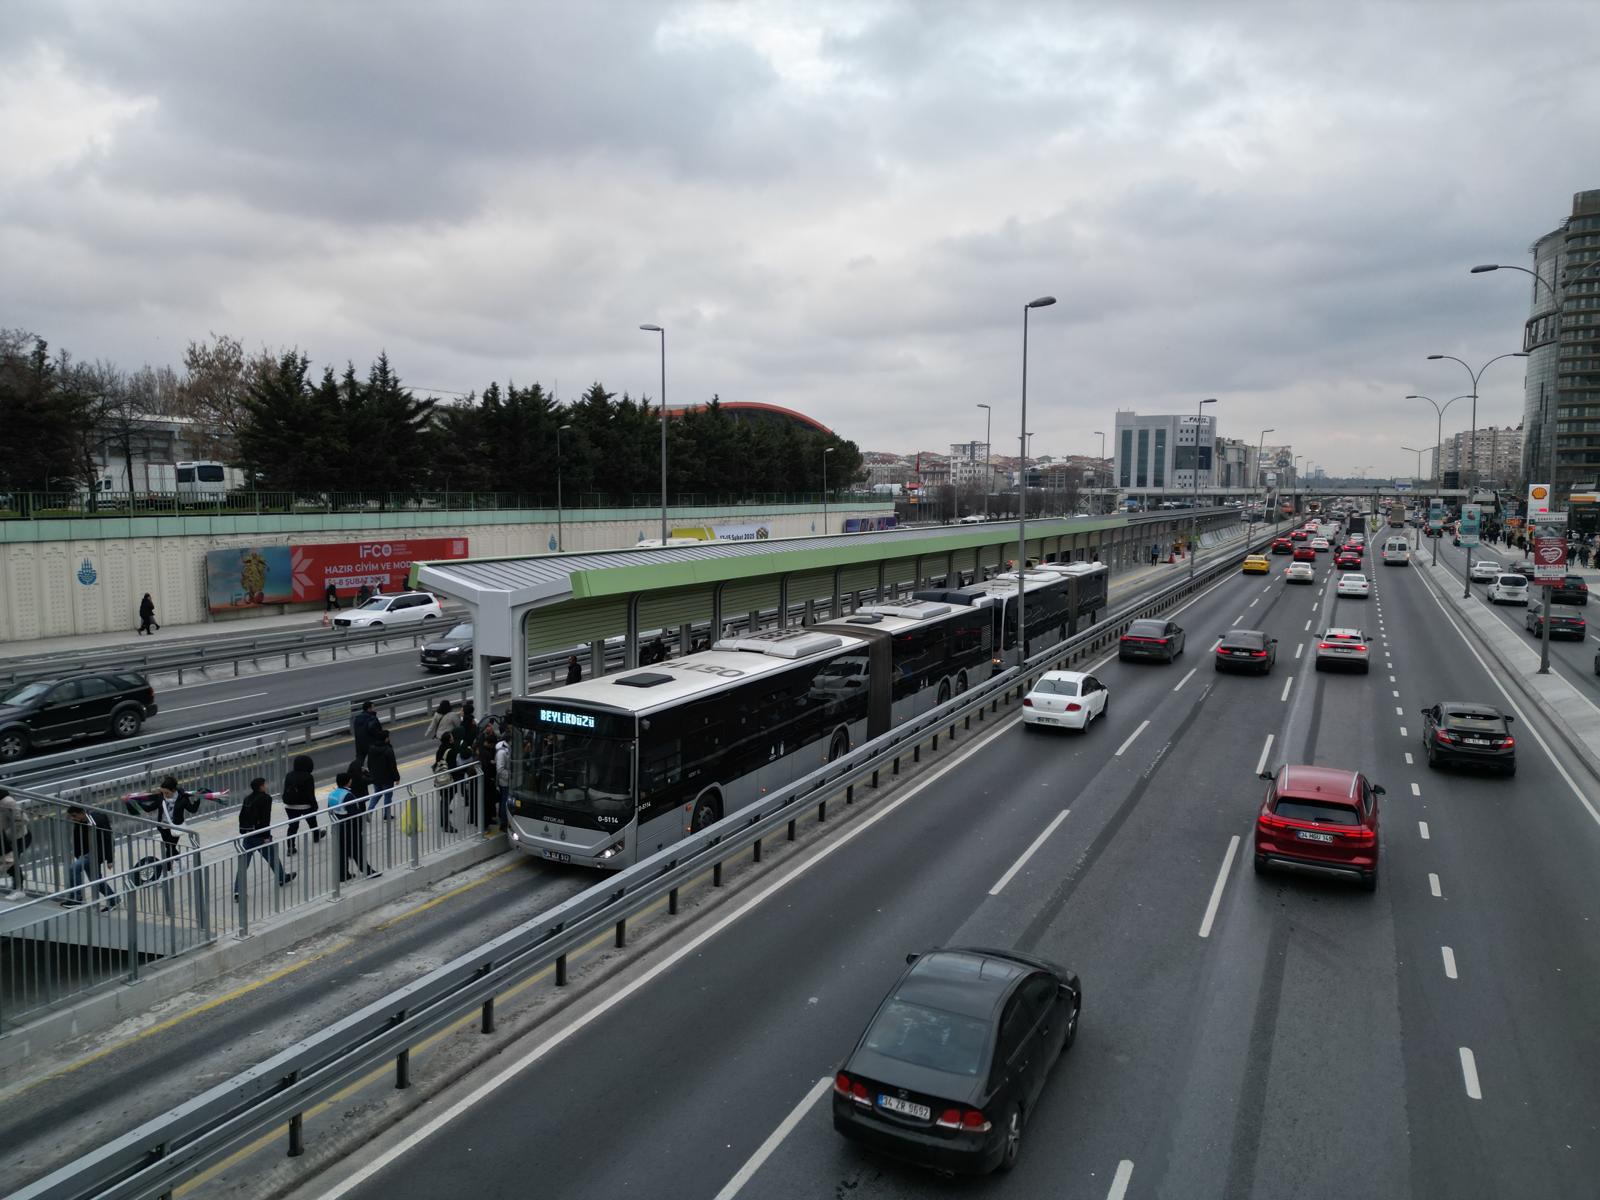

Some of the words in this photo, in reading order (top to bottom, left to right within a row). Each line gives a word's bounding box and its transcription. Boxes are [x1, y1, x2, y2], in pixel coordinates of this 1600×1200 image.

[359, 544, 392, 558] IFCO
[324, 565, 353, 574] HAZIR
[355, 561, 379, 573] GİYİM
[380, 562, 391, 570] VE
[884, 1096, 893, 1106] 34
[895, 1100, 906, 1111] ZR
[908, 1104, 929, 1118] 9692
